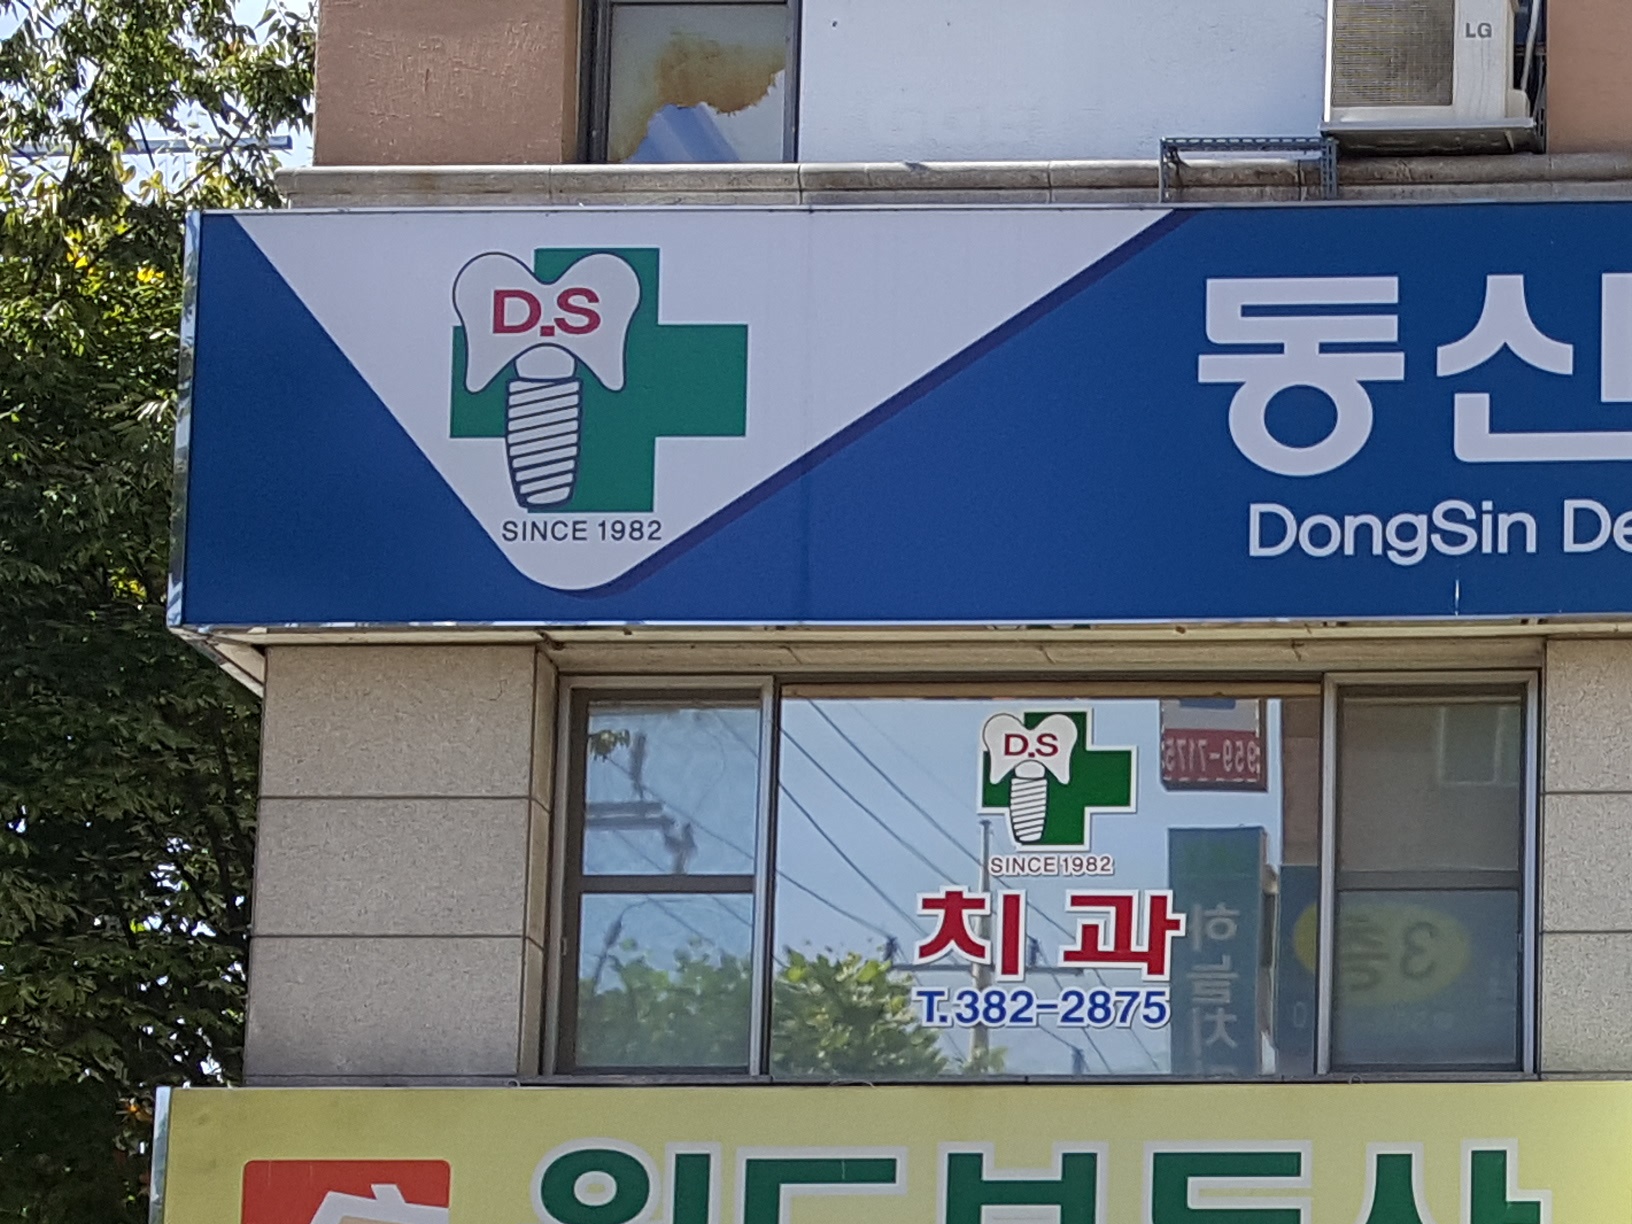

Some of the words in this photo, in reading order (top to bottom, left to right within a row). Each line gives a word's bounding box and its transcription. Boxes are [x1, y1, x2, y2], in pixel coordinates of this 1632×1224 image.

[1464, 21, 1492, 39] LG
[491, 287, 602, 338] D.S
[501, 518, 588, 542] SINCE
[597, 517, 663, 542] 1982
[1248, 499, 1538, 566] DongSin
[1003, 731, 1060, 760] D.S
[990, 855, 1058, 877] SINCE
[1060, 855, 1114, 876] 1982
[916, 988, 1171, 1028] T.382-2875
